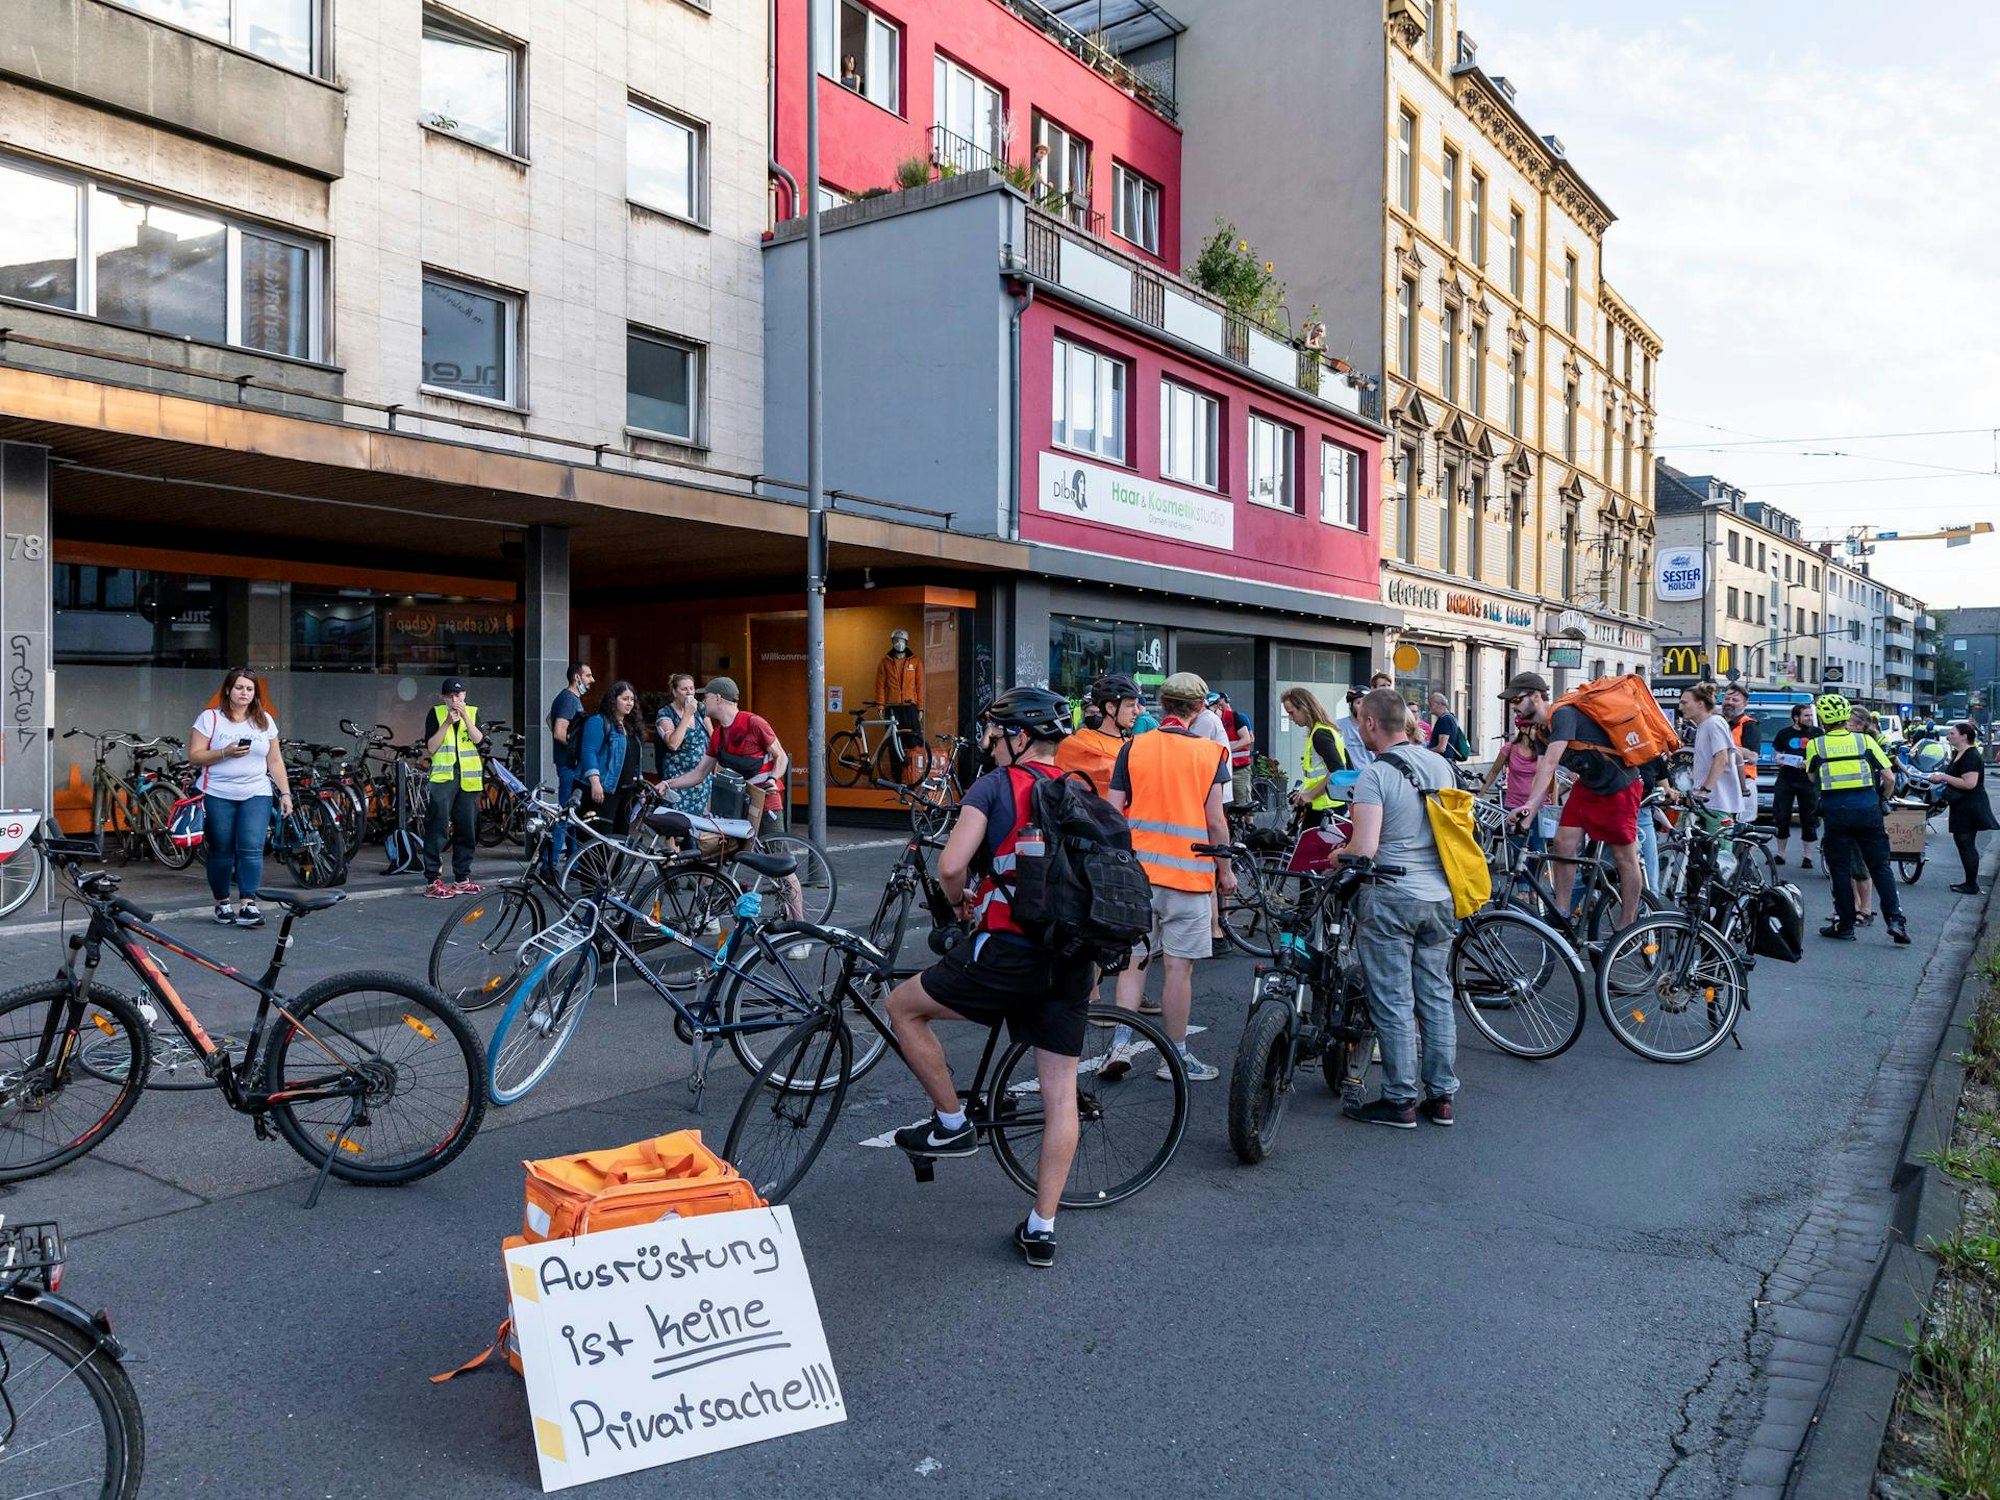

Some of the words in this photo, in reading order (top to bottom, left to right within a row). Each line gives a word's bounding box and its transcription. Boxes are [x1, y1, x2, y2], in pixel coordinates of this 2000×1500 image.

[1112, 481, 1140, 507] Haar
[1141, 495, 1147, 508] &
[1149, 490, 1225, 528] Kosmetikstudio
[5, 533, 44, 561] 78
[1662, 567, 1701, 583] SESTER
[1668, 580, 1696, 591] KÖLSCH
[1594, 624, 1616, 642] PIZZA
[1652, 688, 1682, 697] ald's
[1826, 744, 1857, 755] POLIZEI
[1887, 821, 1913, 839] eitag
[540, 1237, 779, 1295] Ausrüstung
[562, 1320, 634, 1366] ist
[645, 1299, 771, 1349] keine
[570, 1362, 840, 1457] Privatsache!!!
